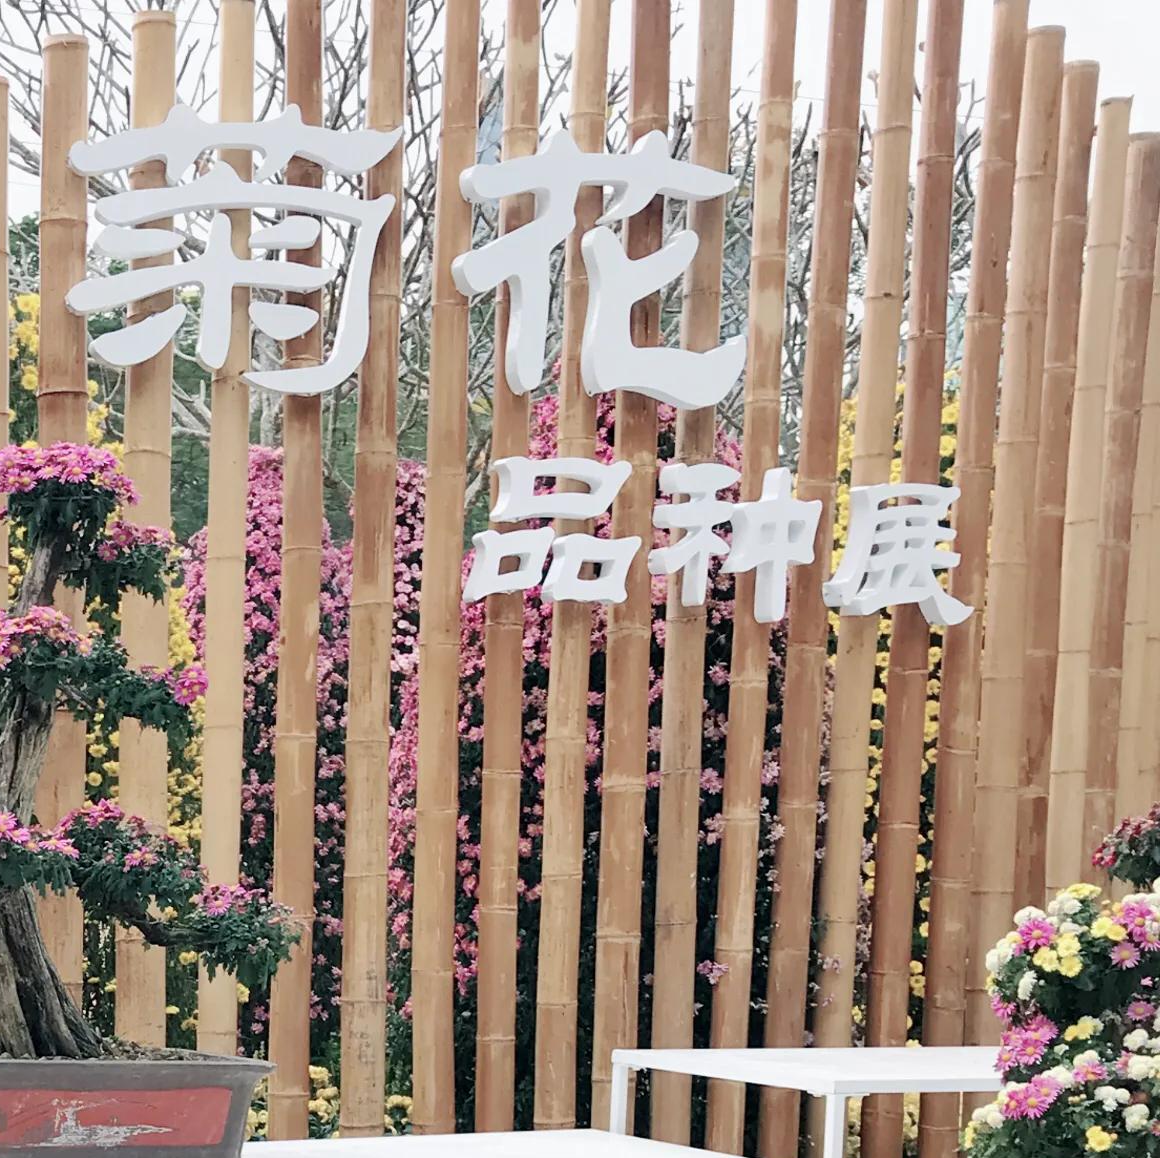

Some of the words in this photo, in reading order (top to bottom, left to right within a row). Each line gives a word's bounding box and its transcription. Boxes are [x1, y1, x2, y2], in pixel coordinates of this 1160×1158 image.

[68, 104, 747, 408] 菊花
[463, 456, 972, 625] 品种展
